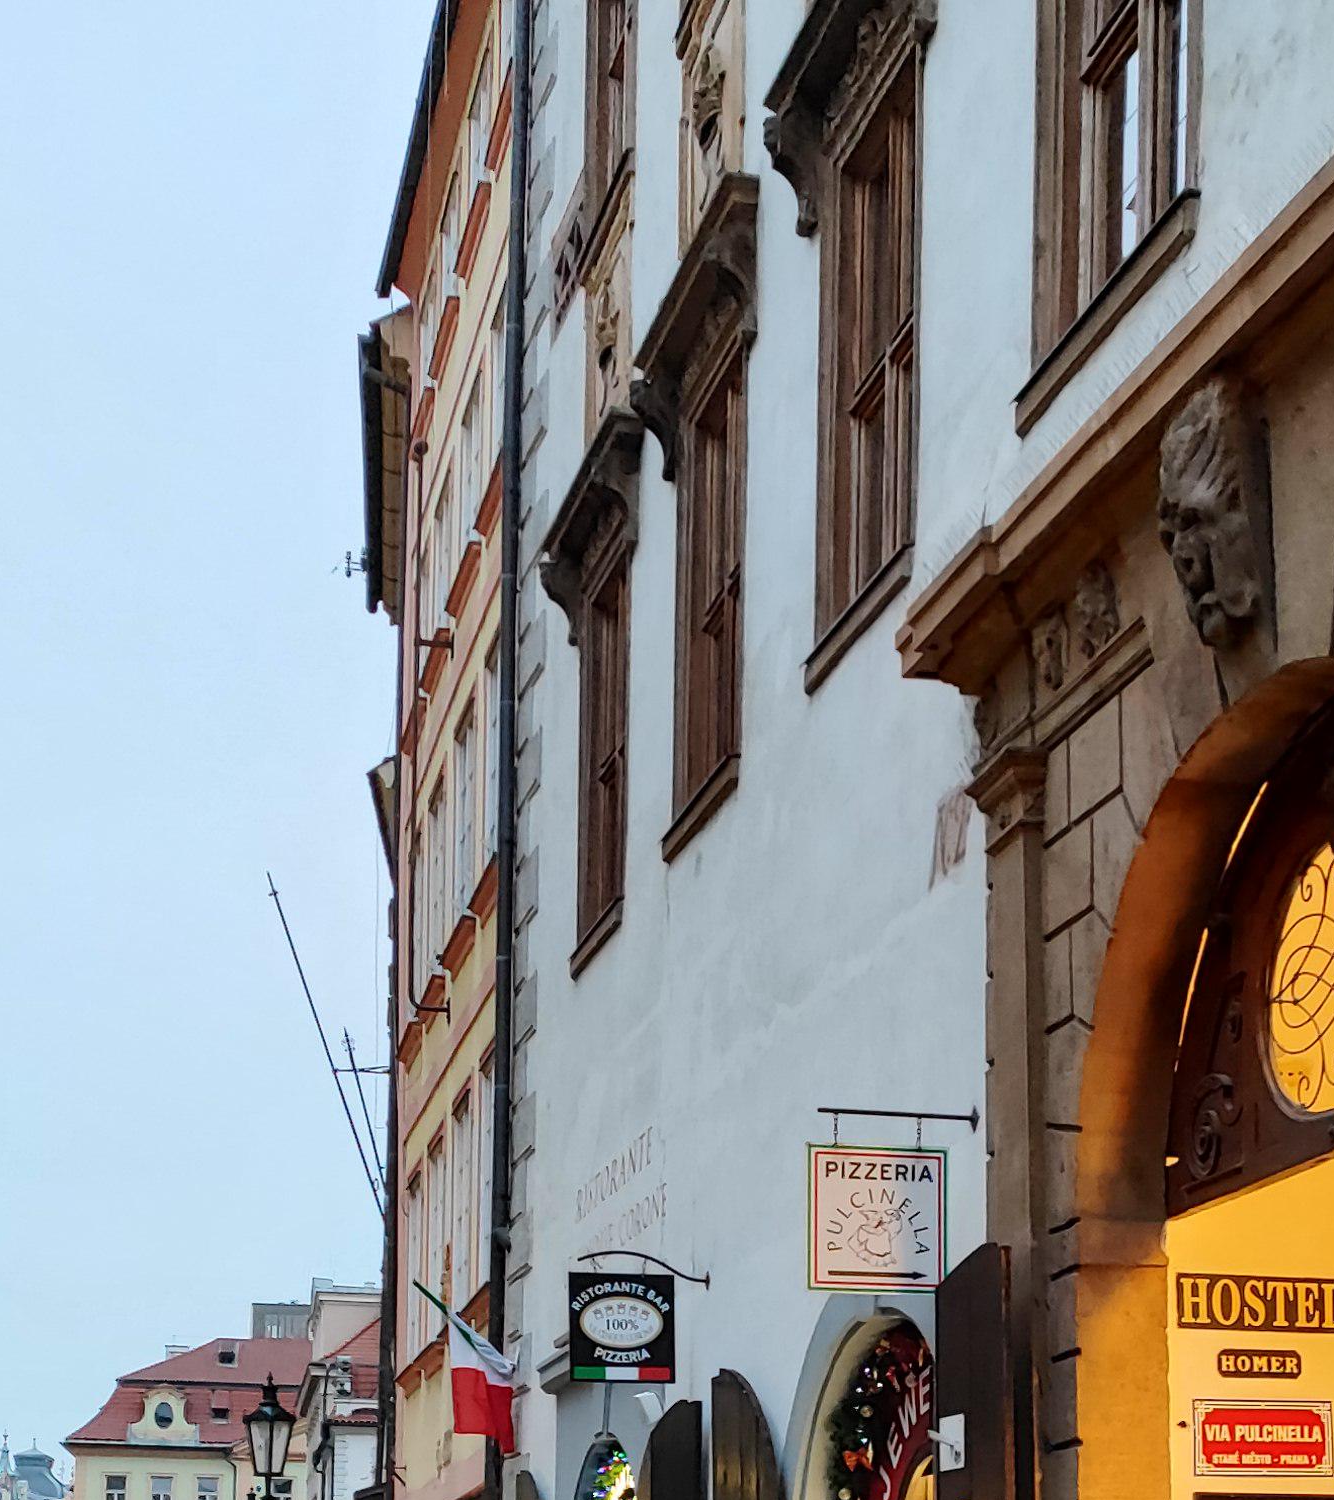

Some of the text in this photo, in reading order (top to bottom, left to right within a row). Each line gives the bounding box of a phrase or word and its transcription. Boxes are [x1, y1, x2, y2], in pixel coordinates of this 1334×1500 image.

[825, 1161, 934, 1183] PIZZERIA
[827, 1188, 931, 1254] PULCINELLA
[571, 1282, 671, 1313] RISTORANTE BAR
[606, 1319, 640, 1331] 100%
[593, 1347, 651, 1363] PIZZERIA
[1220, 1355, 1299, 1374] HOMER
[1204, 1423, 1323, 1443] VIA PULCINELLA
